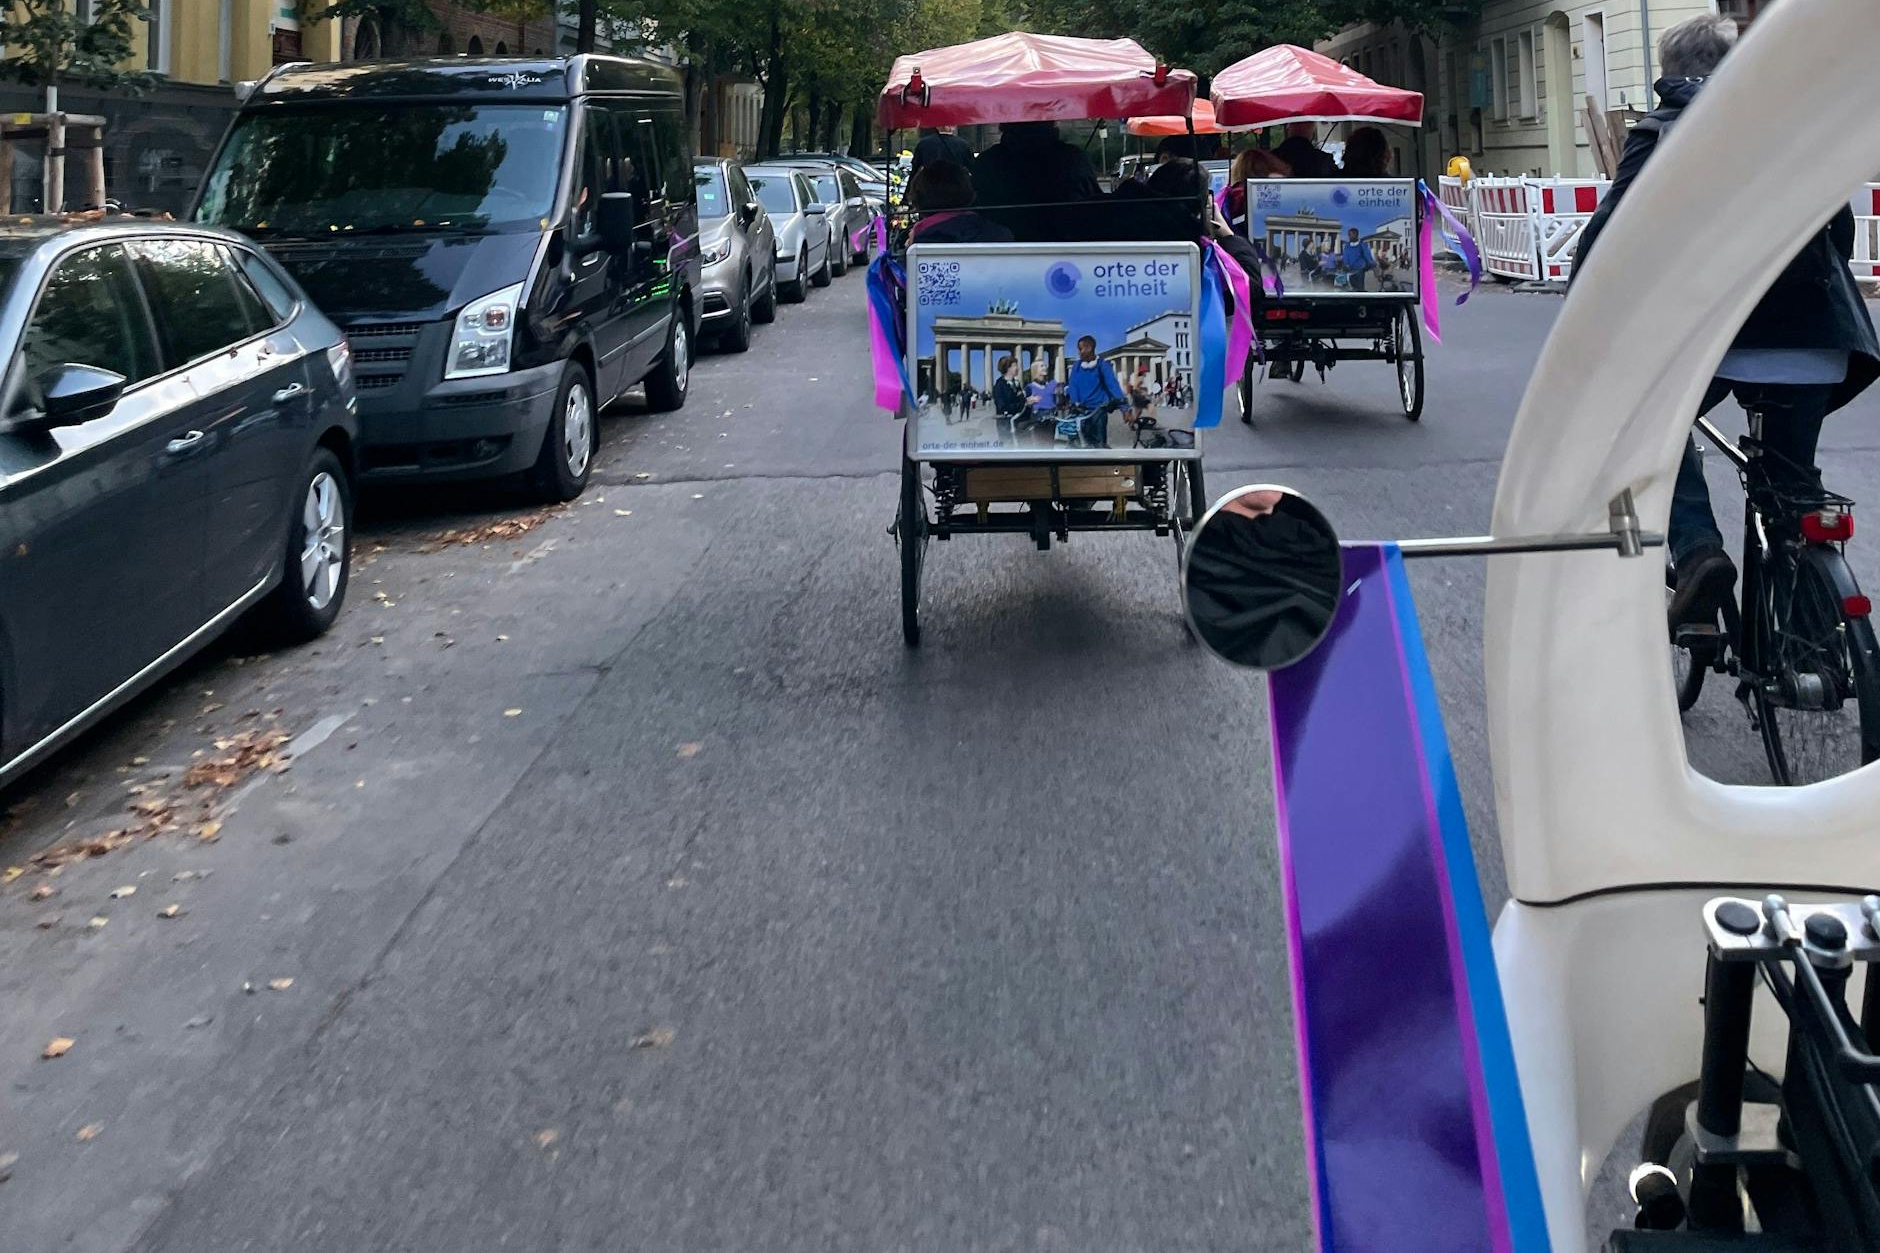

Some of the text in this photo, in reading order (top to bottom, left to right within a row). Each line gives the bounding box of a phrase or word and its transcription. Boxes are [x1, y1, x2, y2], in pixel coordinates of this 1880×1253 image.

[1358, 186, 1408, 197] orte der
[1358, 196, 1401, 208] einheit
[1093, 259, 1180, 278] orte der
[1094, 279, 1168, 297] einheit
